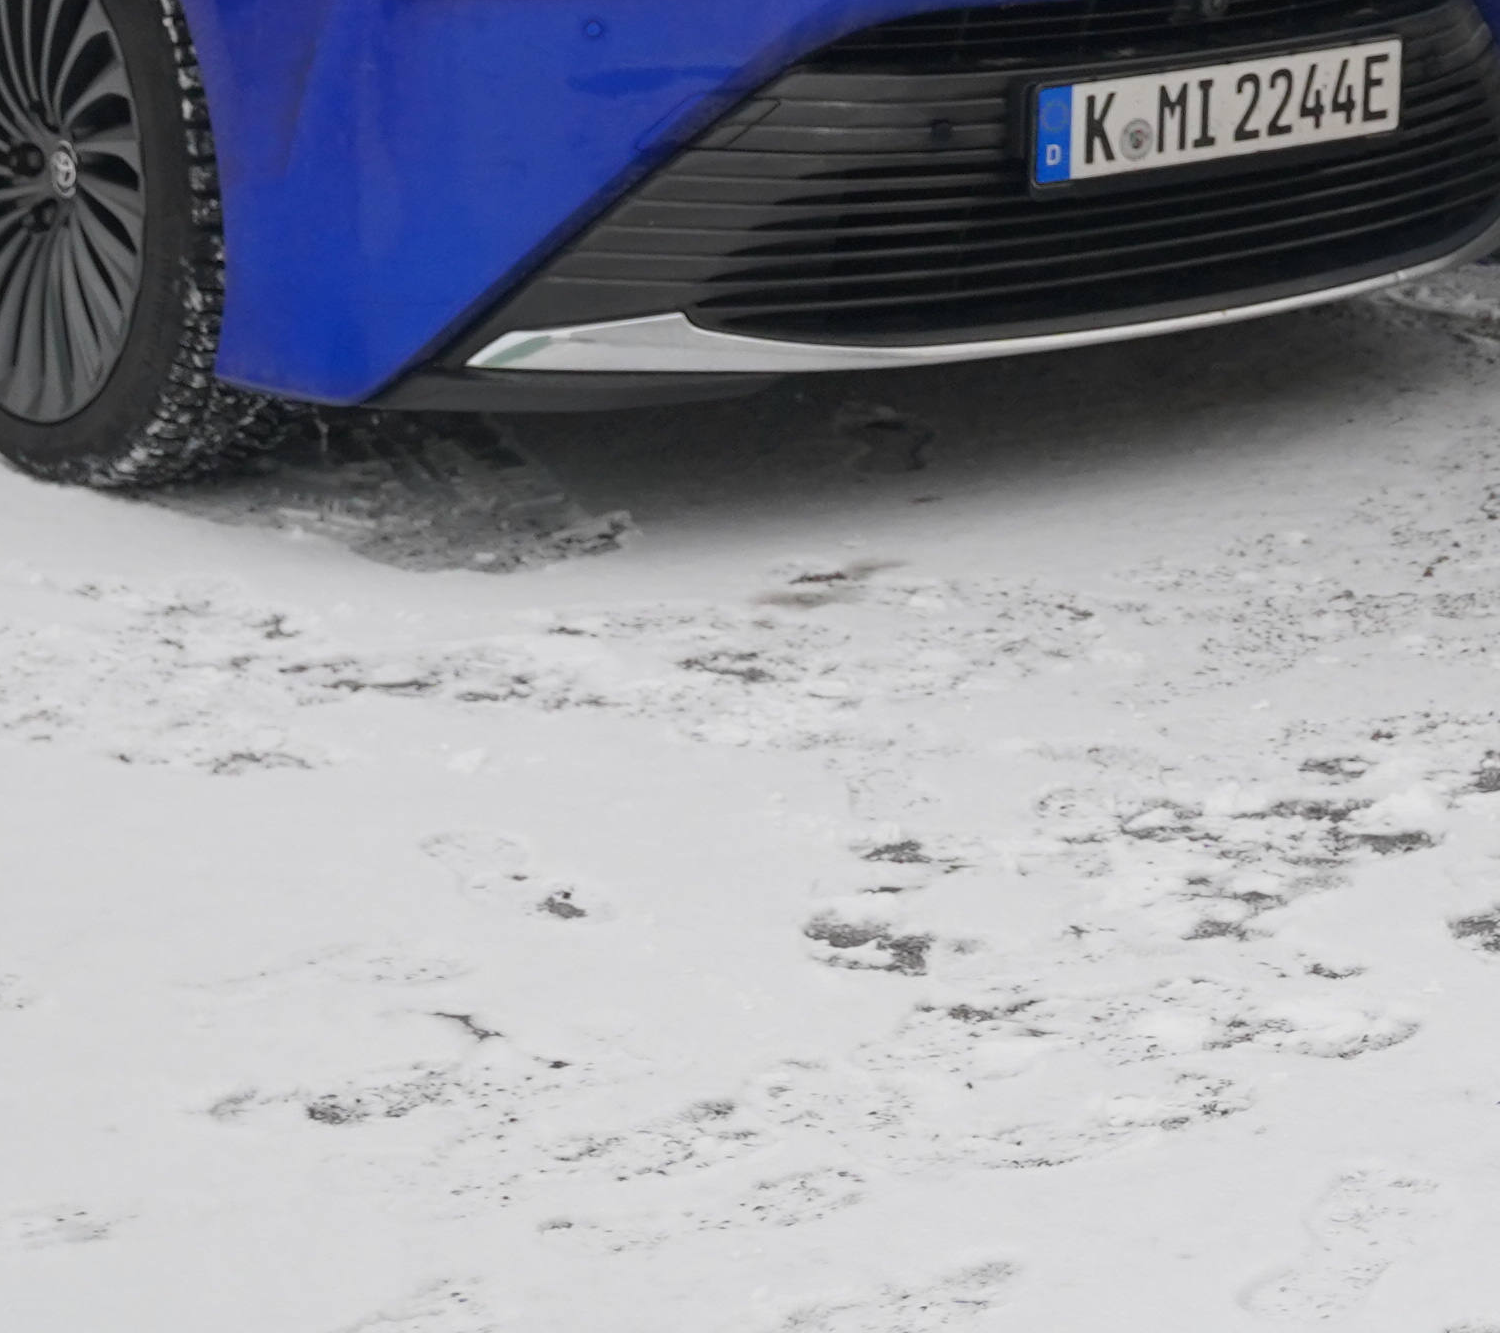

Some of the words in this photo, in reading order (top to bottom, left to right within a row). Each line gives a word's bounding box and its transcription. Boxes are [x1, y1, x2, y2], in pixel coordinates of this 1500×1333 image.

[1084, 92, 1116, 165] K
[1157, 79, 1217, 154] MI
[1234, 53, 1390, 143] 2244E
[1045, 144, 1062, 167] D
